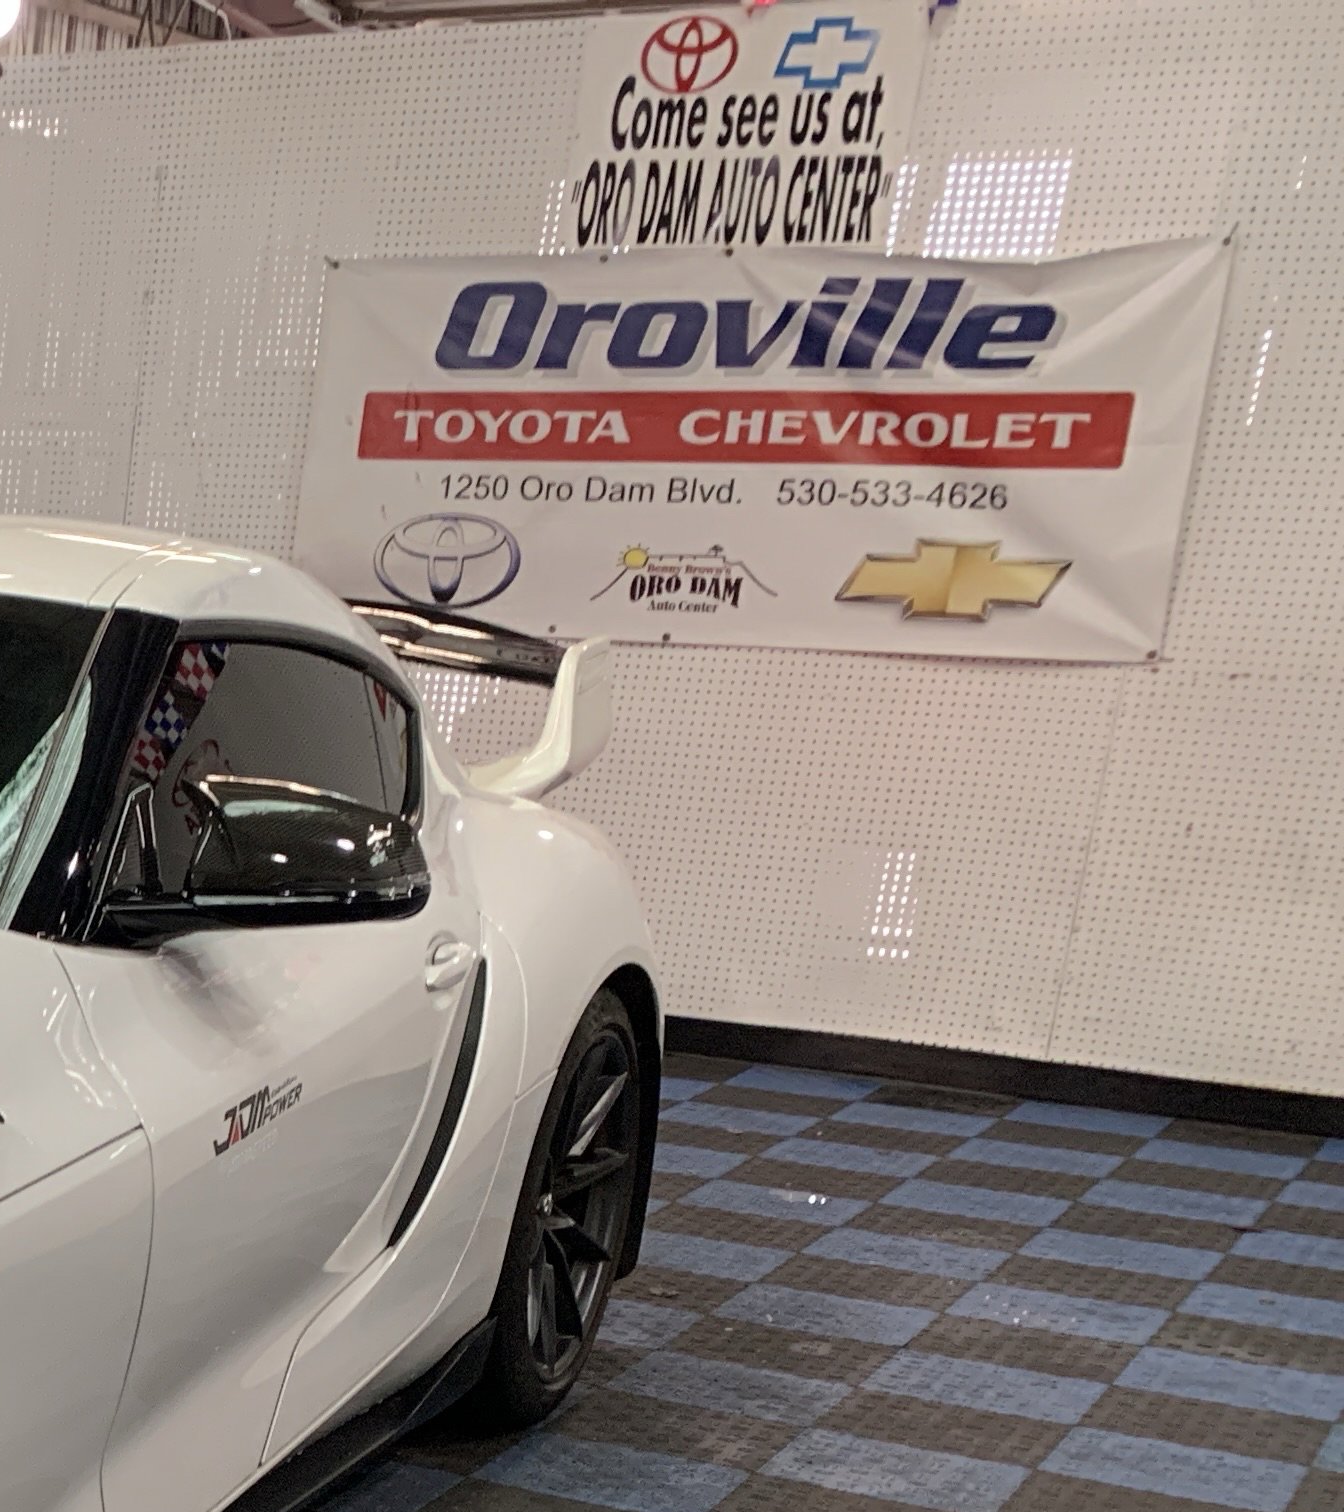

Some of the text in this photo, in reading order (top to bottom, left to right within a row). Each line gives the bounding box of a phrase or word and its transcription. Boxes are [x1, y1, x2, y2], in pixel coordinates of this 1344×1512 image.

[612, 74, 885, 151] Come see us at,
[571, 155, 893, 247] "ORO DAM AUTO CENTER"
[434, 277, 1061, 373] Oroville
[394, 408, 1091, 450] TOYOTA CHEVROLET
[439, 473, 1008, 511] 1250 Oro Dam Blvd. 530-533-4626
[629, 574, 743, 608] ORO DAM
[647, 600, 718, 613] Auto Center
[262, 1083, 302, 1126] POWER
